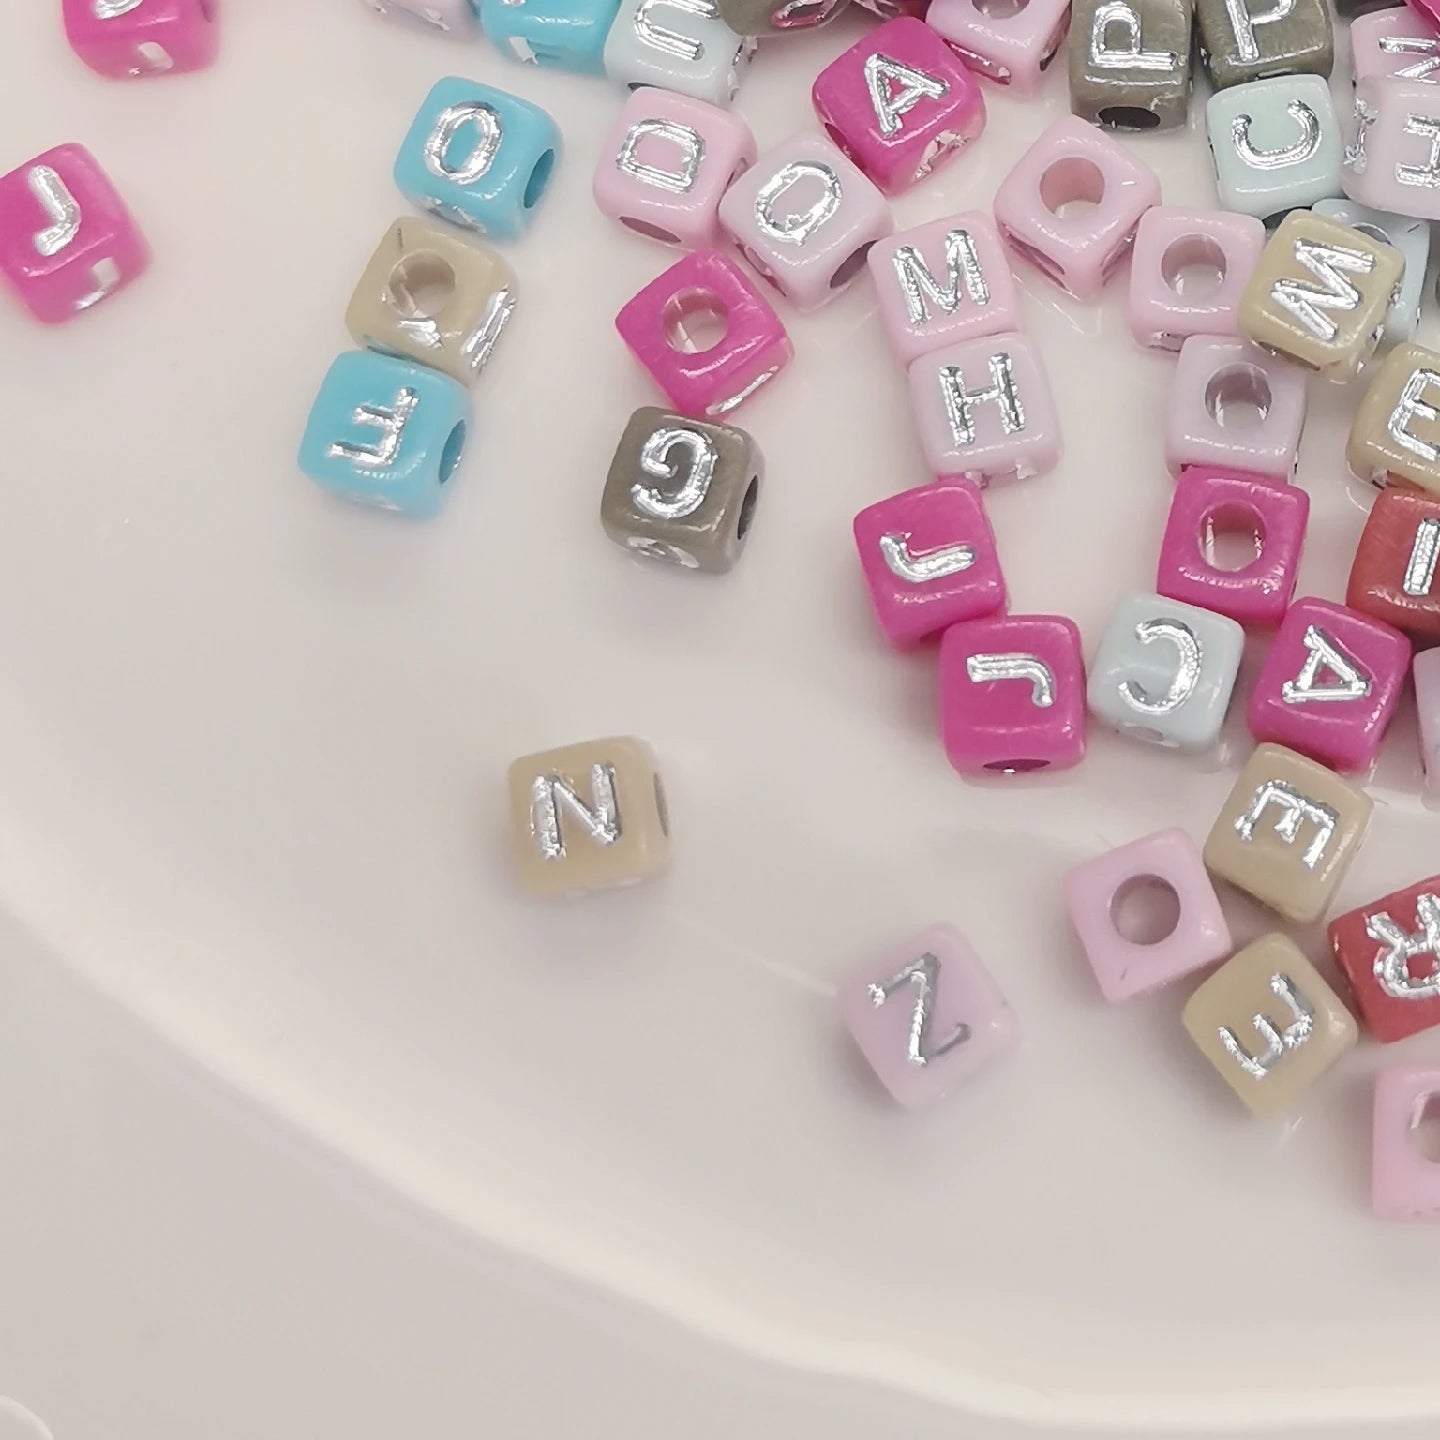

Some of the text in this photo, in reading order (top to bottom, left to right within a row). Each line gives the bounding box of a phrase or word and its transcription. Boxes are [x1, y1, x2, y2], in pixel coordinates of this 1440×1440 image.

[1088, 1, 1185, 71] P
[864, 52, 950, 137] A
[1231, 98, 1324, 170] C
[424, 99, 504, 186] O
[615, 118, 706, 194] D
[28, 164, 81, 257] J
[892, 228, 991, 326] M
[326, 385, 421, 466] F
[938, 351, 1027, 448] H
[631, 426, 719, 519] G
[879, 530, 978, 585] J
[966, 653, 1055, 709] J
[1117, 617, 1204, 715] C
[1282, 625, 1373, 703] A
[531, 761, 623, 860] N
[1234, 779, 1341, 869] E
[1217, 972, 1315, 1081] E
